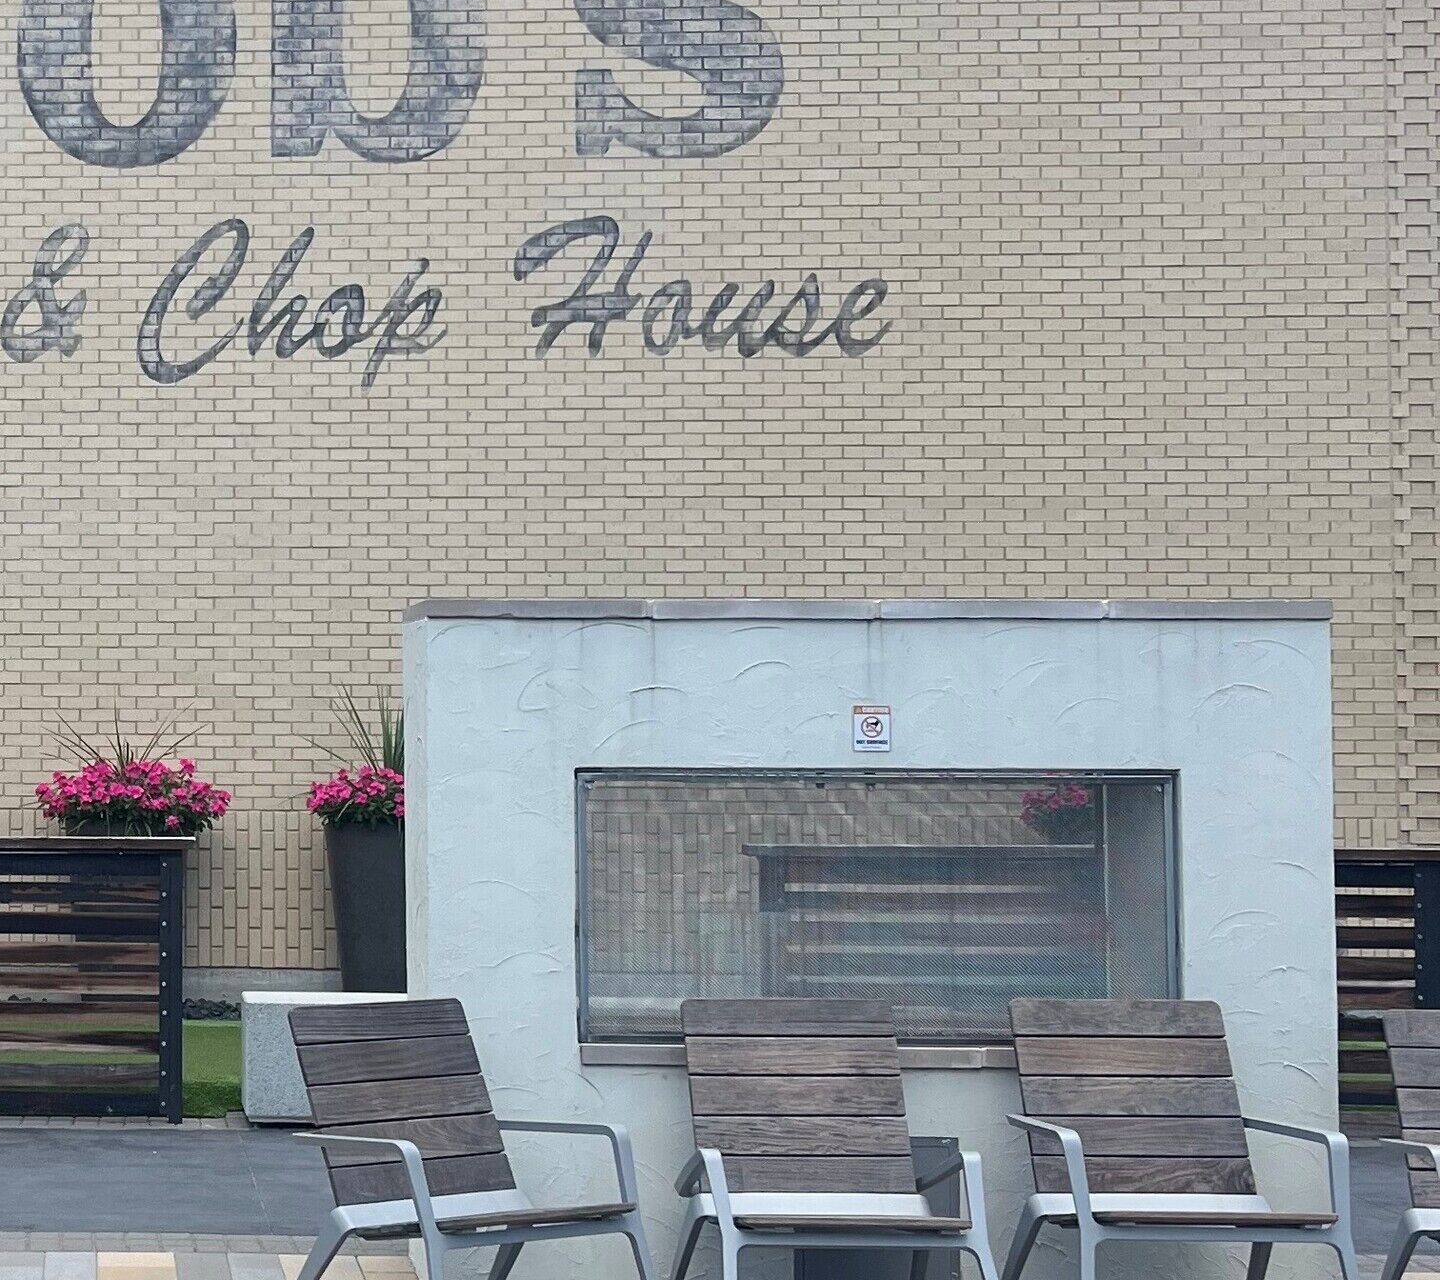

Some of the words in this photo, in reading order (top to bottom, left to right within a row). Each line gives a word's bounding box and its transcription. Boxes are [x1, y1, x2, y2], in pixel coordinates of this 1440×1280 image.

[0, 222, 90, 363] &
[136, 217, 448, 394] Chop
[513, 215, 893, 360] House
